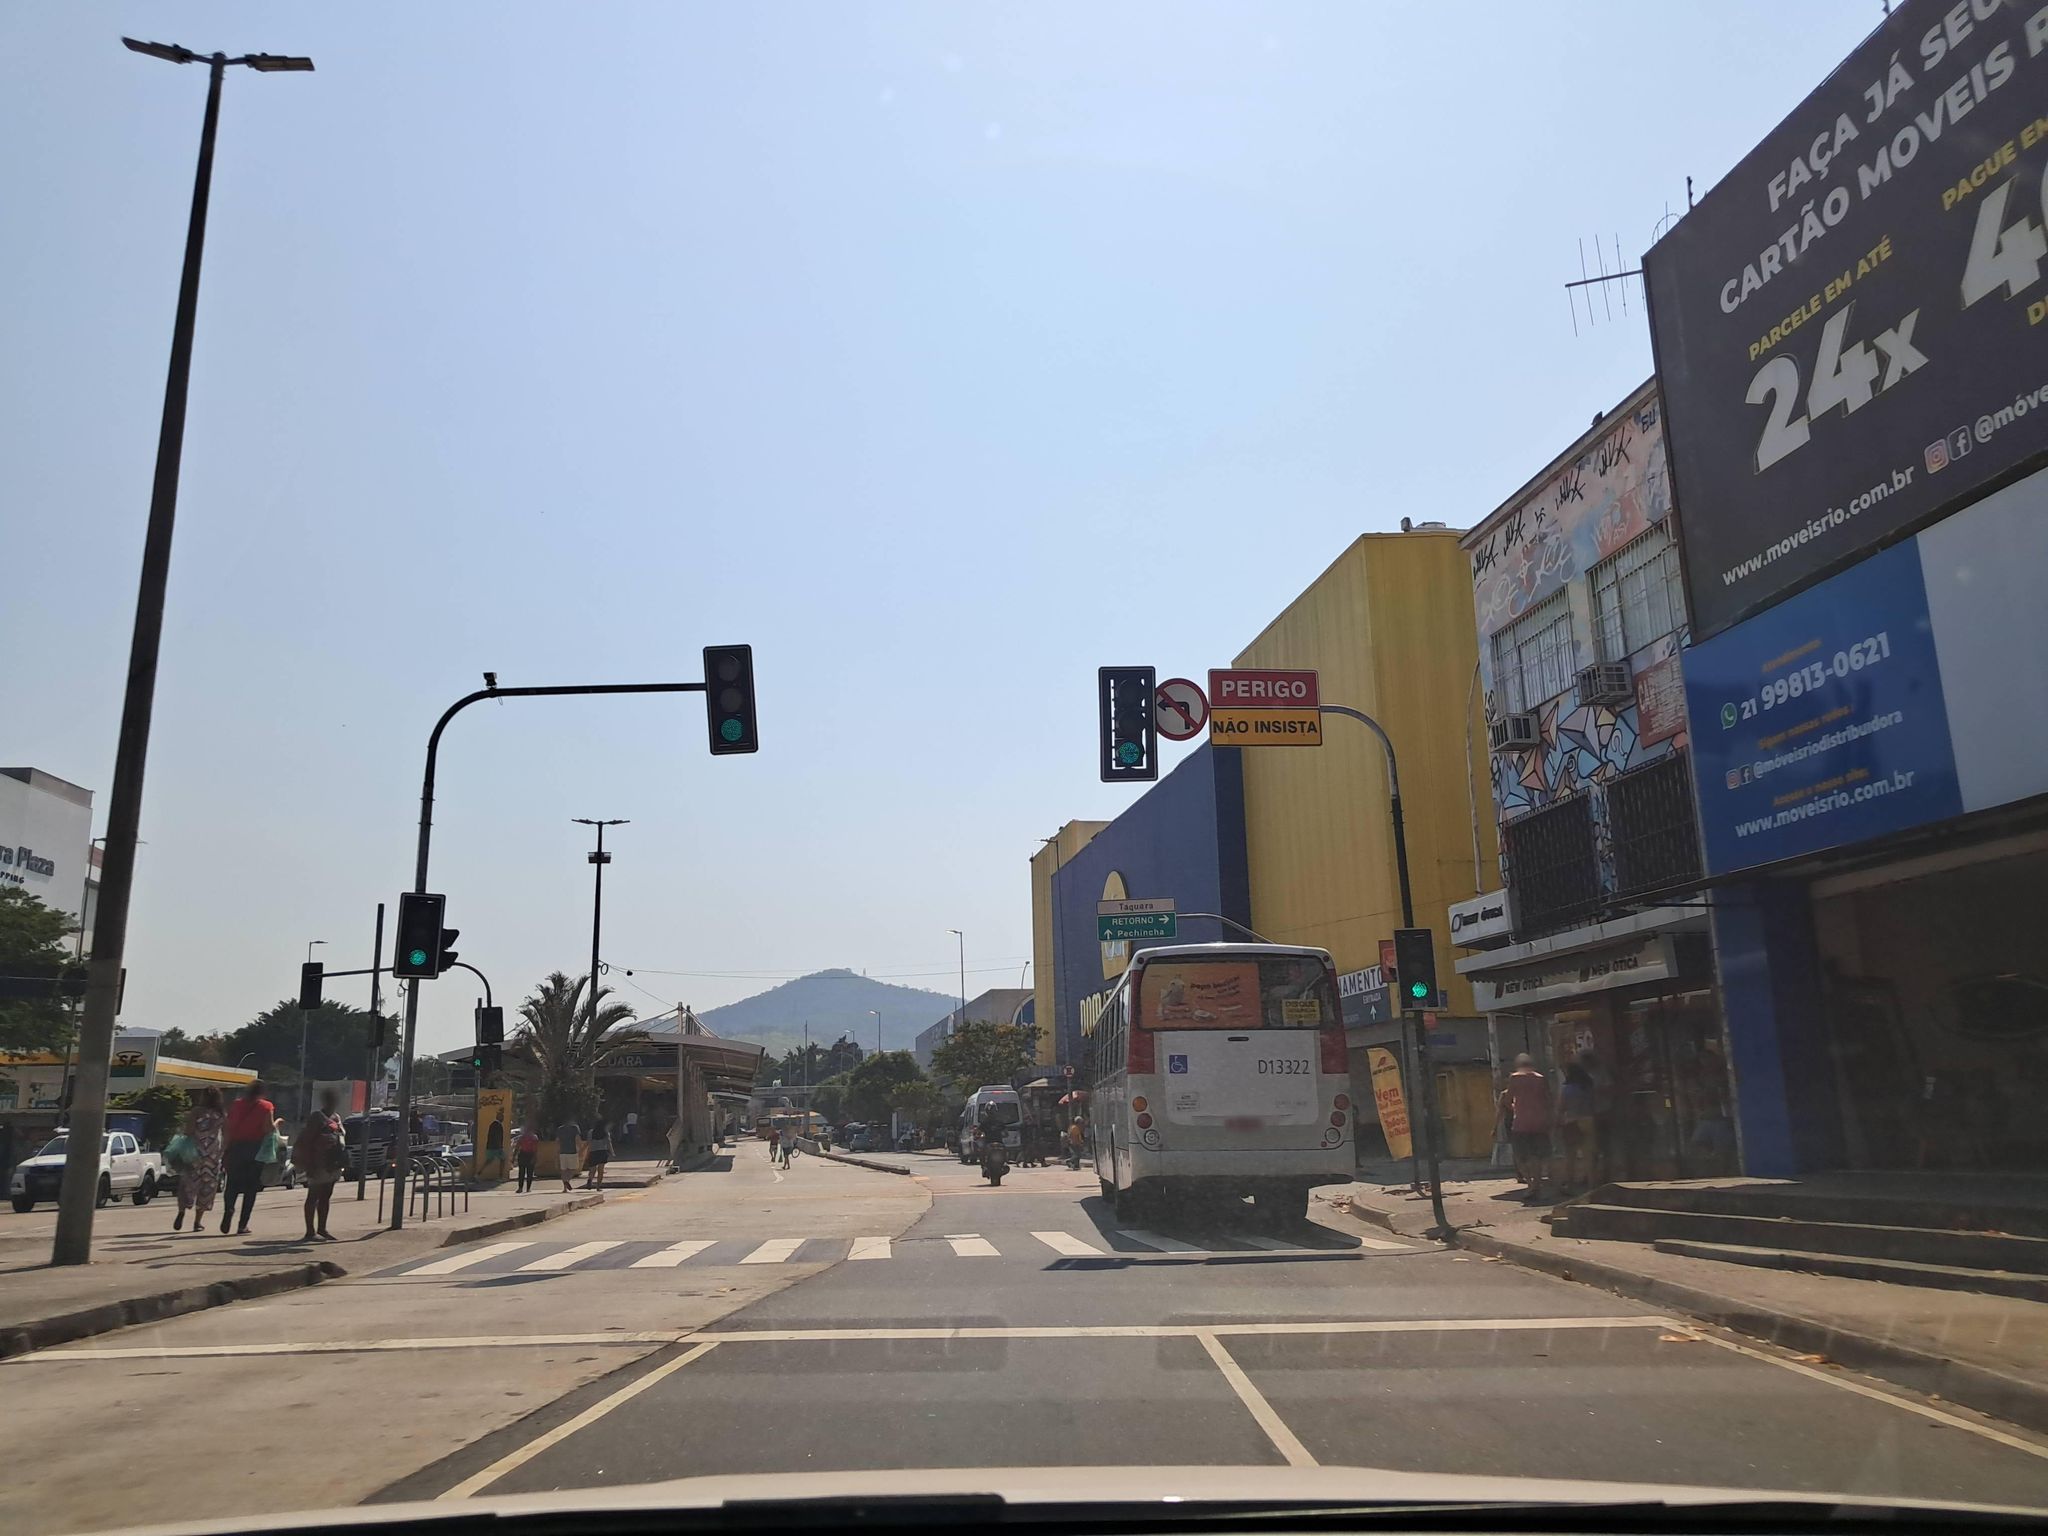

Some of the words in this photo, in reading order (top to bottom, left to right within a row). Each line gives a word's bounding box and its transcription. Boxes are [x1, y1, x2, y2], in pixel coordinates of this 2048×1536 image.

[1767, 112, 1860, 214] FAÇA
[1863, 48, 1915, 124] JÁ
[1719, 186, 1850, 314] CARTÃO
[1856, 40, 2015, 201] MOVEIS
[1942, 140, 2017, 211] PAGUE
[1960, 173, 2048, 311] 4
[1748, 293, 1822, 361] PARCELE
[1824, 269, 1852, 304] EM
[1856, 234, 1892, 280] ATÉ
[1722, 466, 1915, 586] www.moveisrio.com.br
[1221, 680, 1307, 698] PERIGO
[1740, 697, 1758, 720] 21
[1761, 631, 1891, 711] 99813-0621
[1212, 717, 1249, 734] NÃO
[1254, 720, 1318, 734] INSISTA
[1735, 769, 1915, 838] www.moveisrio.com.br
[17, 846, 55, 877] Plaza
[1112, 917, 1154, 926] RETORNO
[1117, 928, 1165, 938] Pechincha
[1119, 902, 1154, 911] Taquara
[1258, 1059, 1311, 1075] D13322
